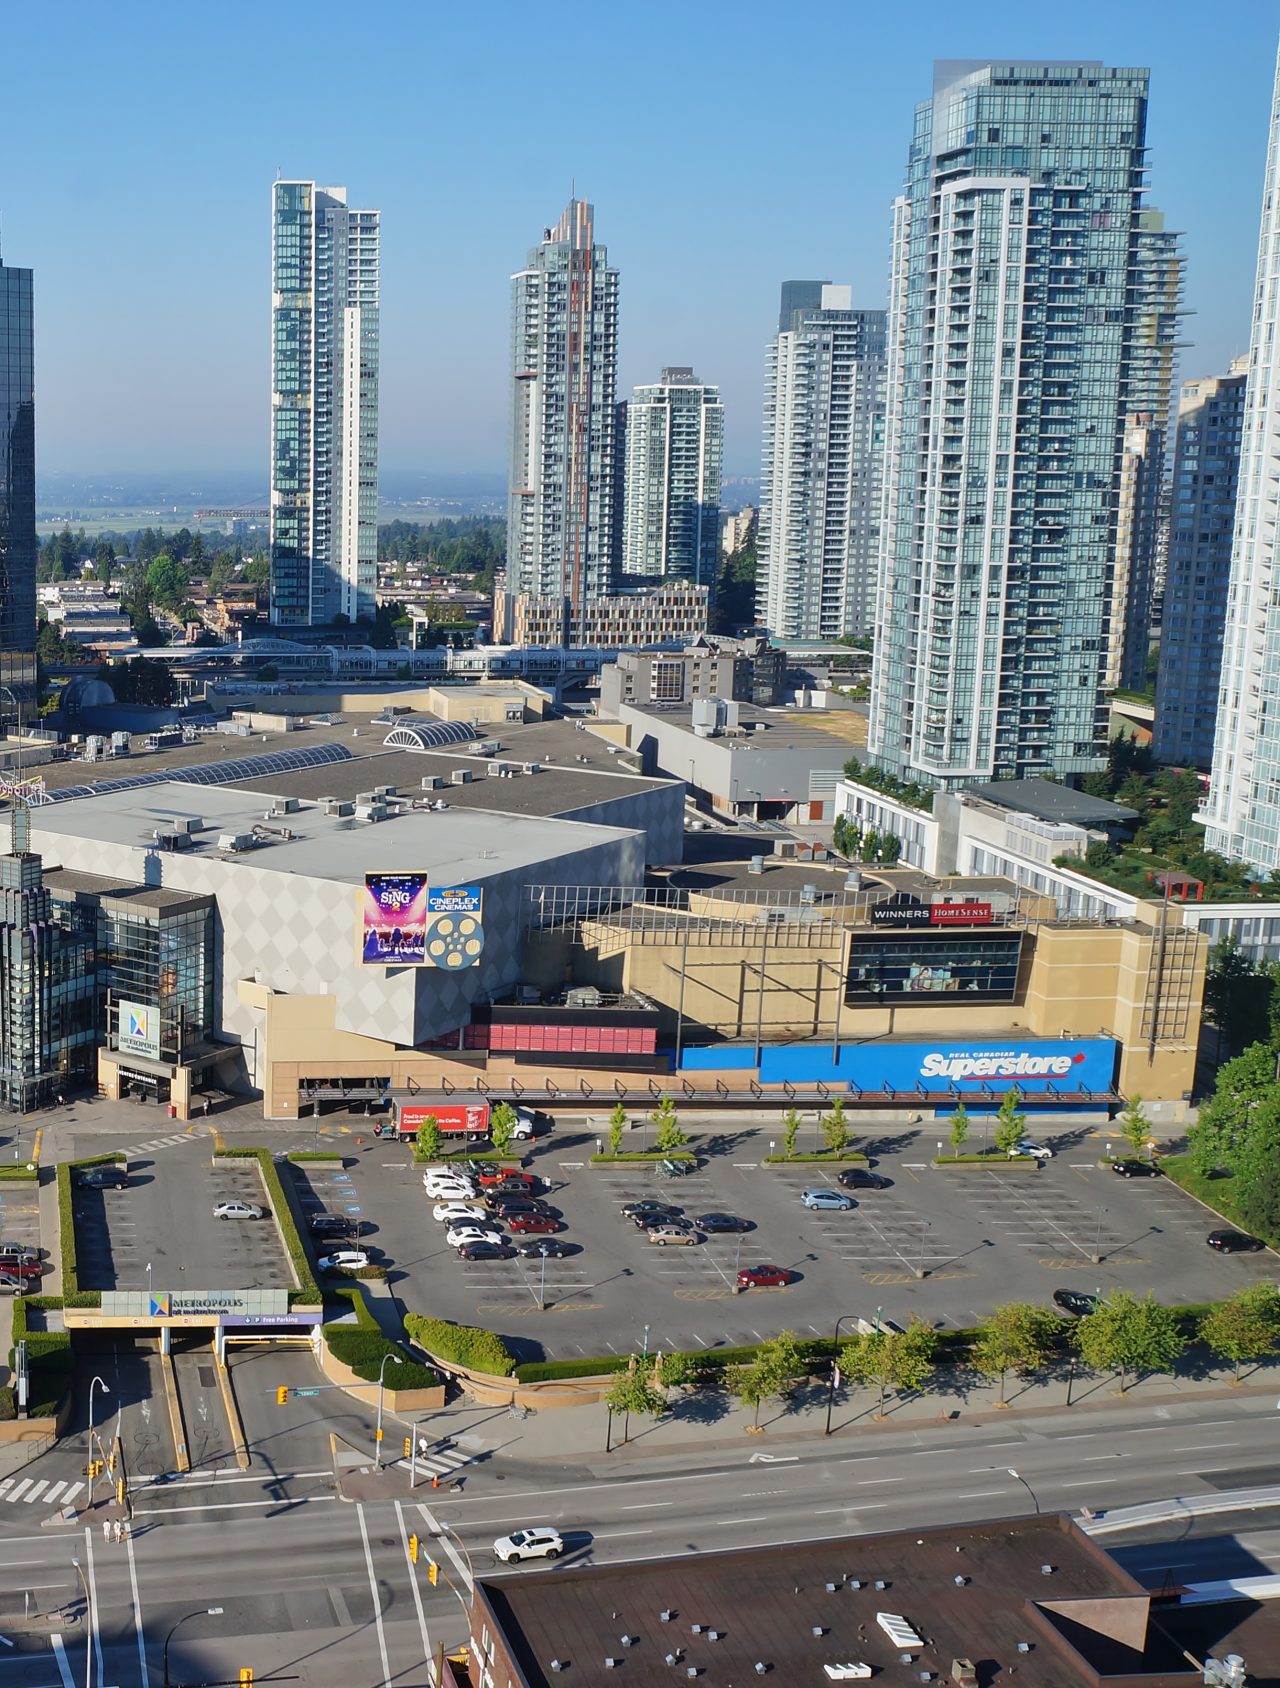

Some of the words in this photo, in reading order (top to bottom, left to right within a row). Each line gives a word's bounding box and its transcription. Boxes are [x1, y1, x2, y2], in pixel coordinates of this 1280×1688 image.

[392, 901, 401, 911] 2
[429, 897, 479, 905] CINEPLEX
[874, 910, 930, 918] WINNERS
[120, 1036, 158, 1051] METROPOLIS
[920, 1052, 1072, 1081] Superstore
[173, 1298, 244, 1308] METROPOLIS
[276, 1316, 299, 1325] Parking
